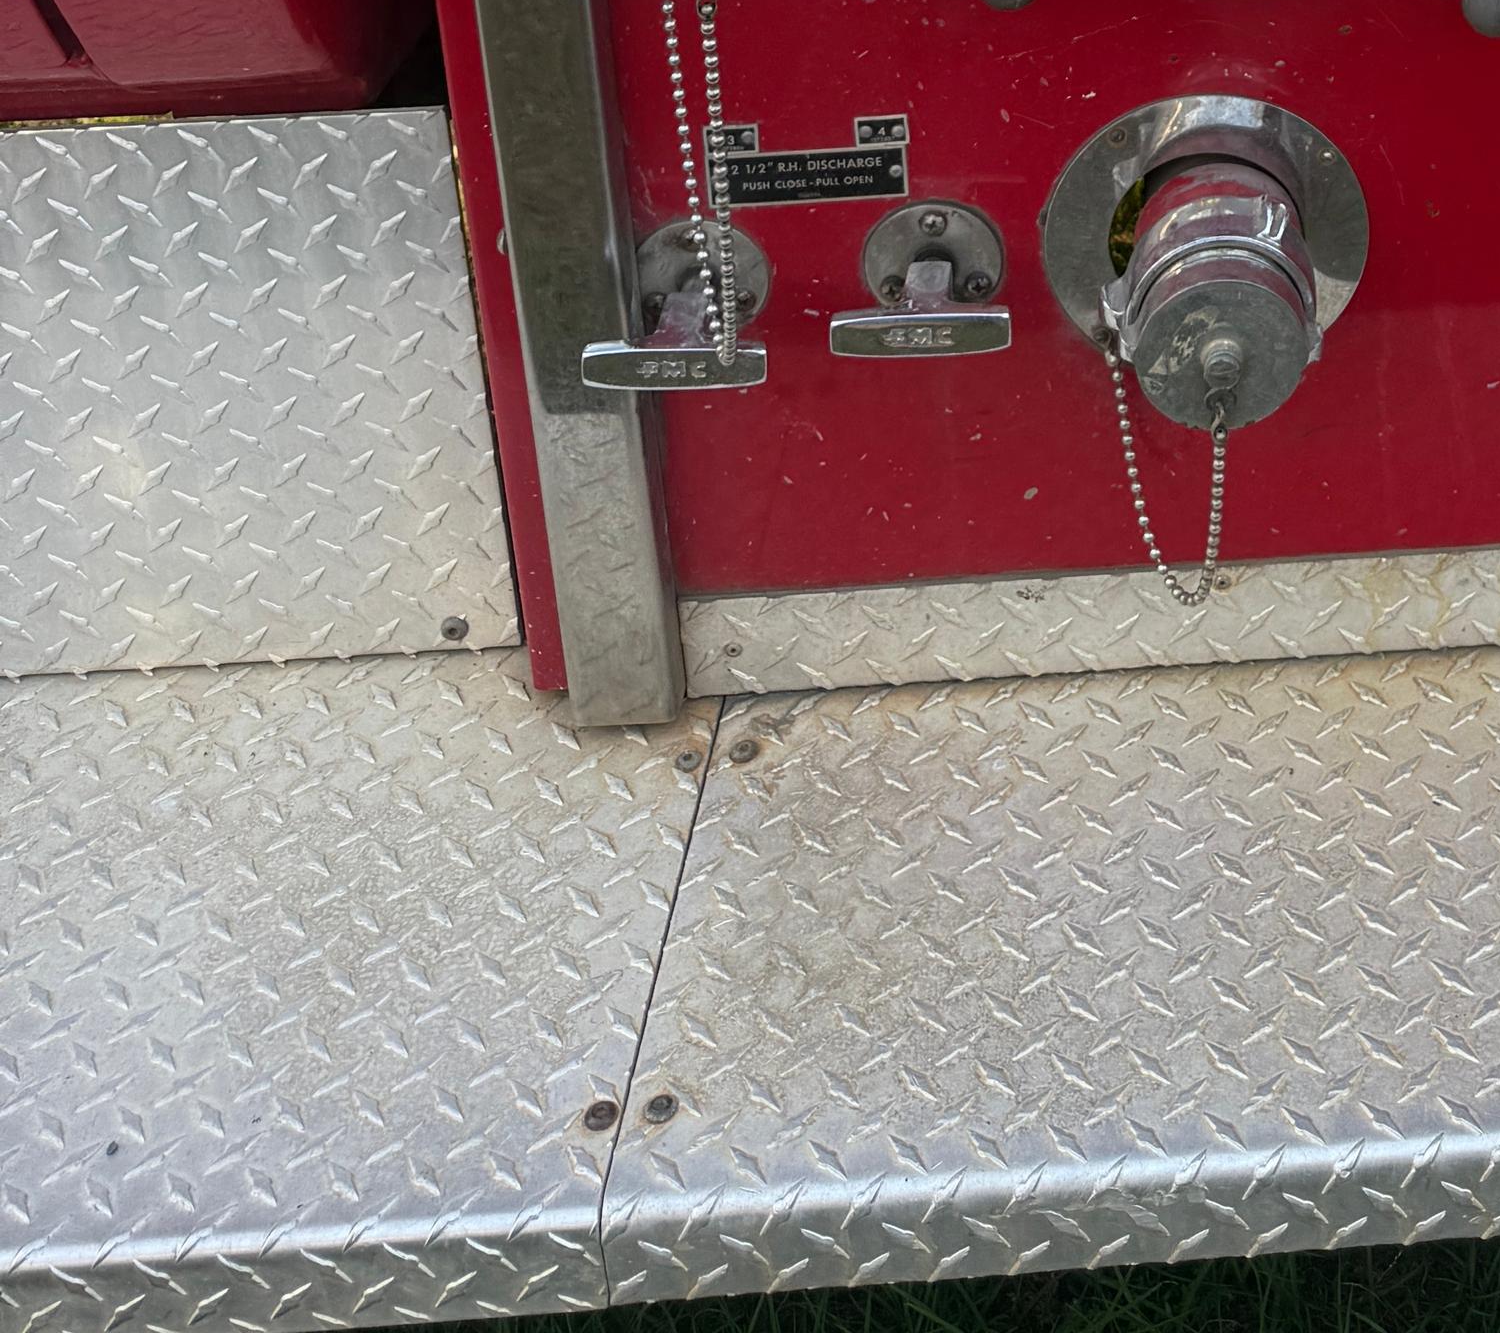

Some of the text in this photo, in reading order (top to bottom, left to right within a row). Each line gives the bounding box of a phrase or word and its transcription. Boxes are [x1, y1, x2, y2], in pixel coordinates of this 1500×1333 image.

[877, 126, 886, 137] 4
[728, 135, 735, 146] 3
[807, 157, 882, 171] DISCHARGE
[743, 176, 873, 190] PUSH OPEN
